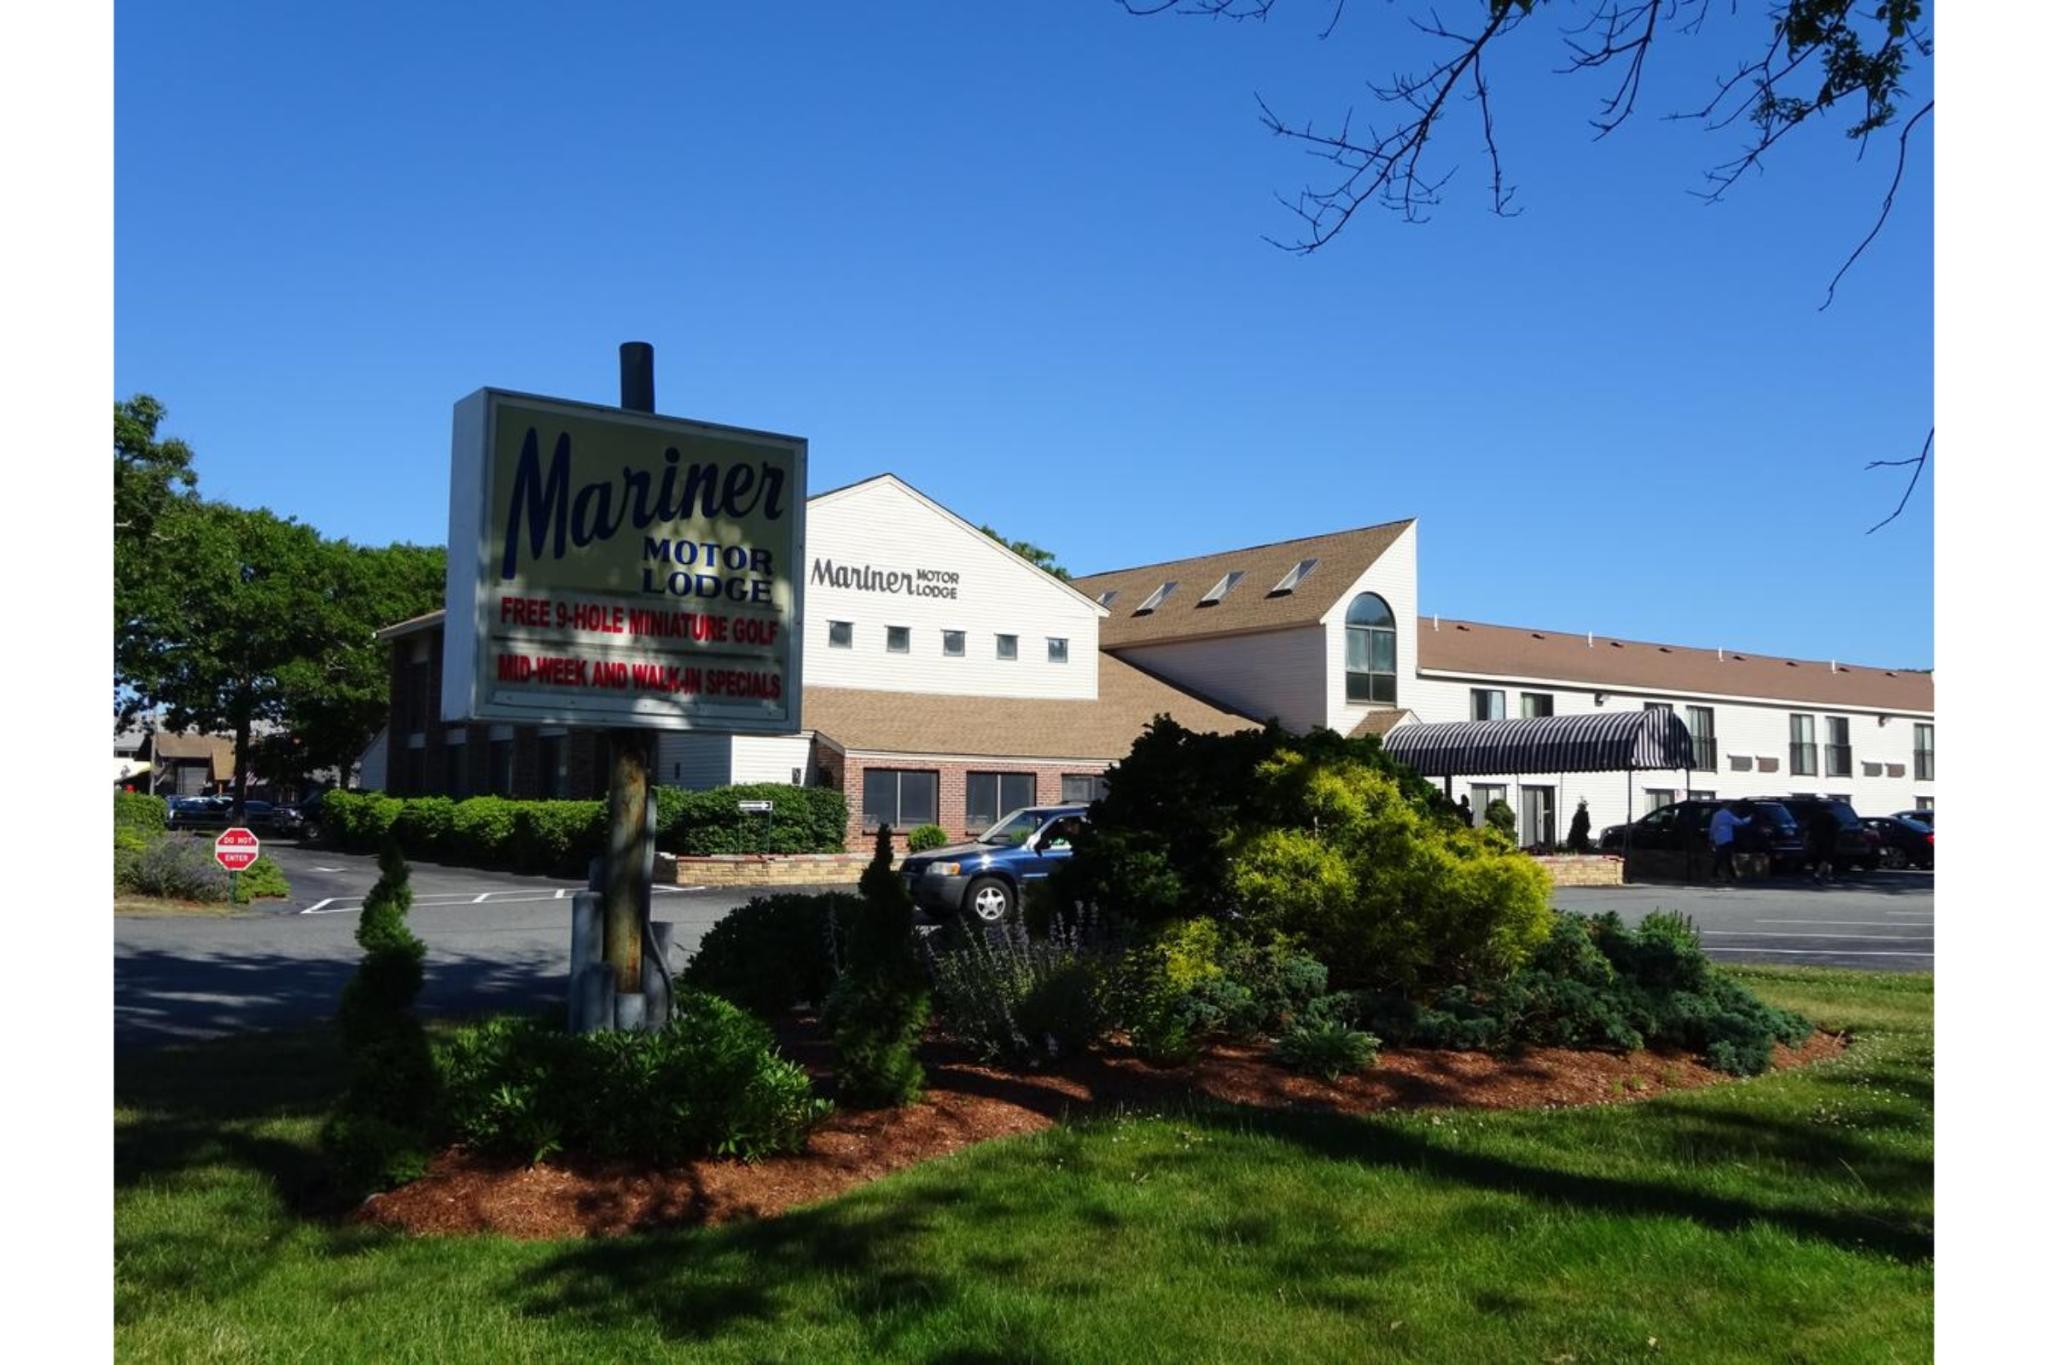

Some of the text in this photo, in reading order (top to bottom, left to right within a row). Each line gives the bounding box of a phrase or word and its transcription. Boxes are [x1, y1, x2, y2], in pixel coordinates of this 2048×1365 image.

[502, 426, 785, 580] Mariner
[643, 537, 773, 575] MOTOR
[642, 570, 774, 604] LODGE
[810, 558, 915, 595] Mariner
[916, 569, 959, 584] MOTOR
[916, 584, 957, 599] LODGE
[502, 597, 778, 645] FREE 9-HOLE MINIATURE GOLF
[498, 655, 780, 698] MID-WEEK AND WALK-IN SPECIALS
[223, 836, 235, 844] DO
